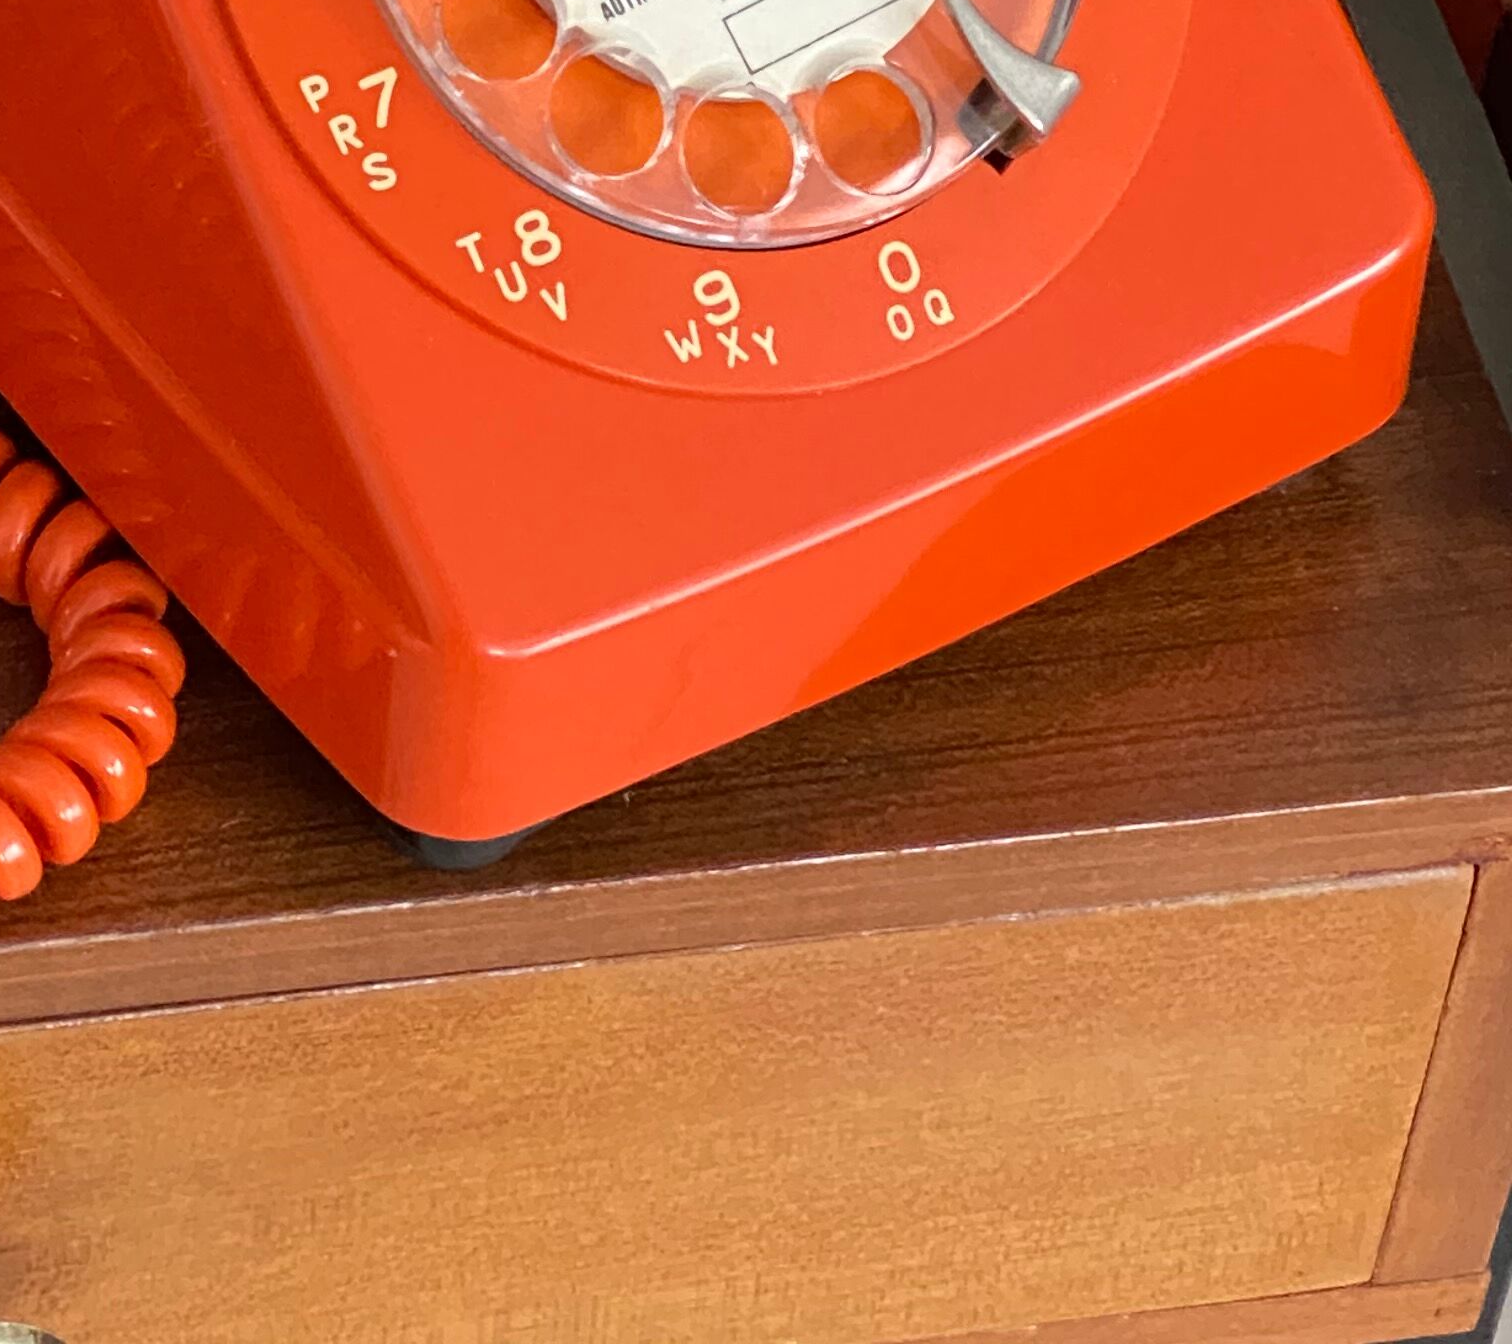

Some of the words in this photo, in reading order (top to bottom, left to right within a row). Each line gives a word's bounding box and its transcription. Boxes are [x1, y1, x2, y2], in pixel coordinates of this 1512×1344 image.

[359, 66, 398, 129] 7
[513, 209, 562, 267] 8
[693, 269, 741, 326] 9
[664, 319, 778, 368] WXY
